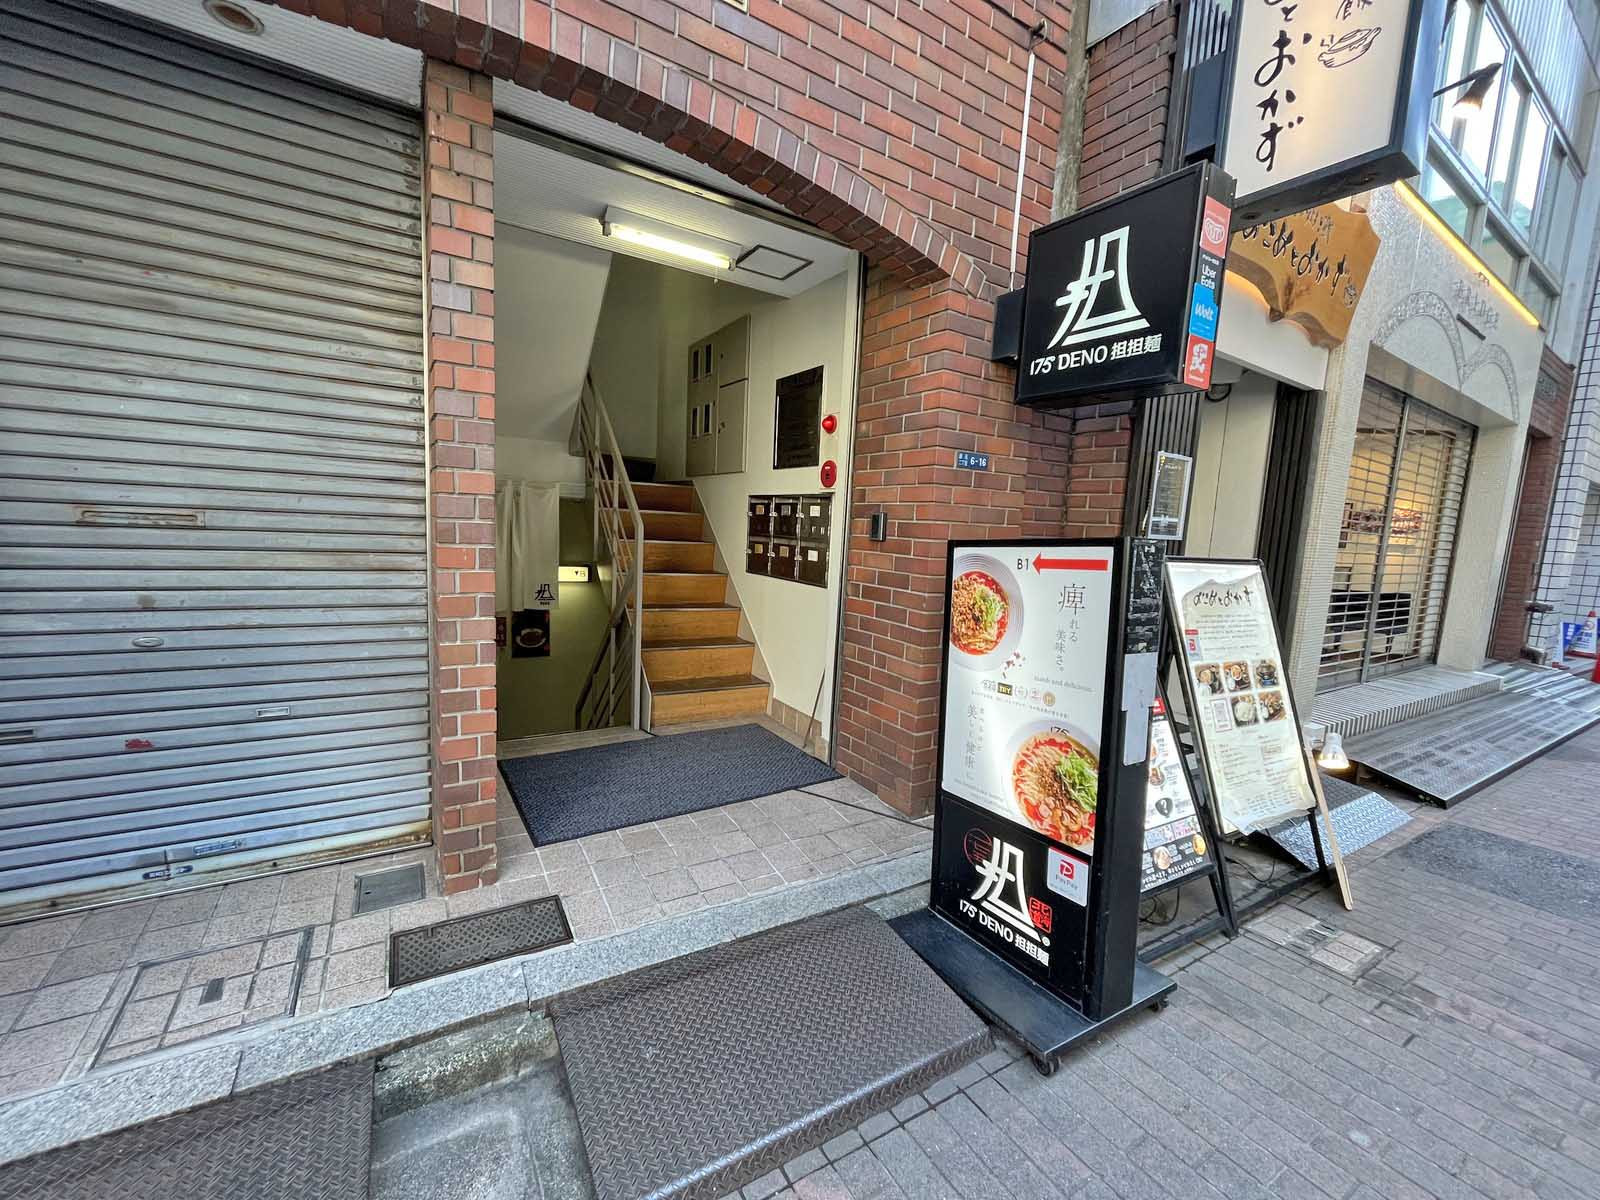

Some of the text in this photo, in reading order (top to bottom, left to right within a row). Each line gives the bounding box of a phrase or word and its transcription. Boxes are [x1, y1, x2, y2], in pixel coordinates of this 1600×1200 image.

[1254, 0, 1304, 172] とおかず
[1202, 263, 1217, 279] Uber
[1200, 275, 1215, 290] Eats
[1194, 303, 1214, 321] Wolt
[1058, 346, 1108, 371] DENO
[1110, 333, 1162, 360] 担担麺
[1016, 558, 1029, 570] B1
[979, 909, 1014, 942] DENO
